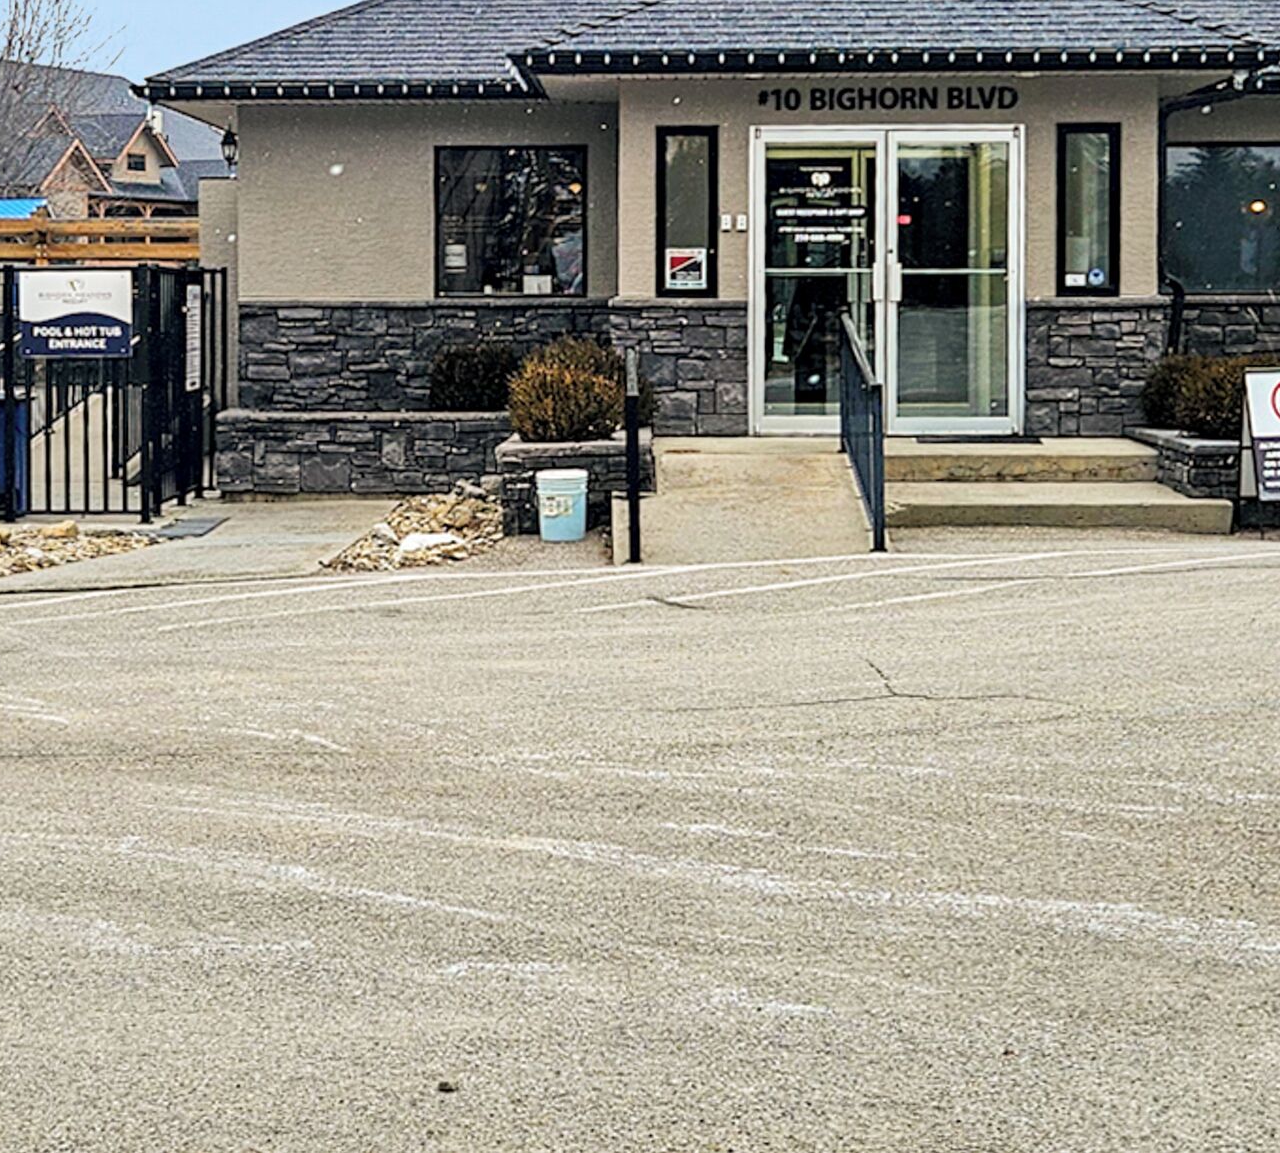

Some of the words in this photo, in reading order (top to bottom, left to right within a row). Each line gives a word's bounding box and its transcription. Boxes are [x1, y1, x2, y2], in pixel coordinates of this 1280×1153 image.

[758, 88, 801, 111] #10
[810, 87, 938, 111] BIGHORN
[947, 86, 1018, 110] BLVD
[33, 326, 63, 338] POOL
[64, 326, 73, 337] &
[74, 326, 98, 337] HOT
[99, 326, 122, 337] TUB
[48, 338, 107, 350] ENTRANCE
